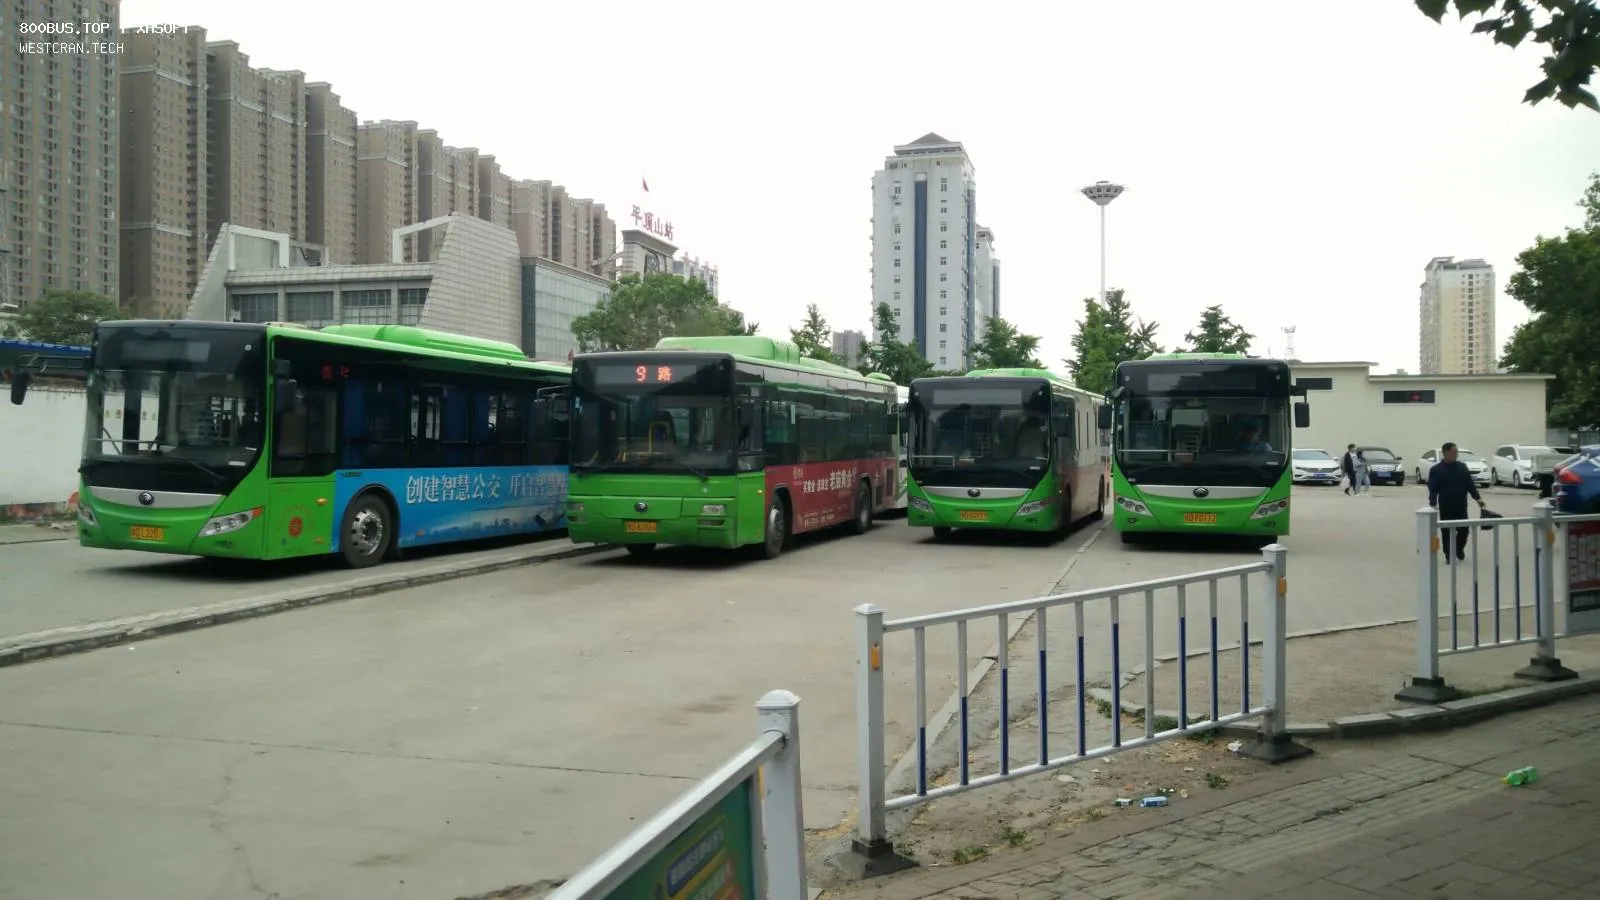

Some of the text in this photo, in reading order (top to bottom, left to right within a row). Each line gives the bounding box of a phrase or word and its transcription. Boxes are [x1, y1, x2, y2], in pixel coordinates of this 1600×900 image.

[631, 205, 673, 241] 平顶山站
[635, 365, 647, 382] 9
[406, 473, 501, 504] 创建智慧公交
